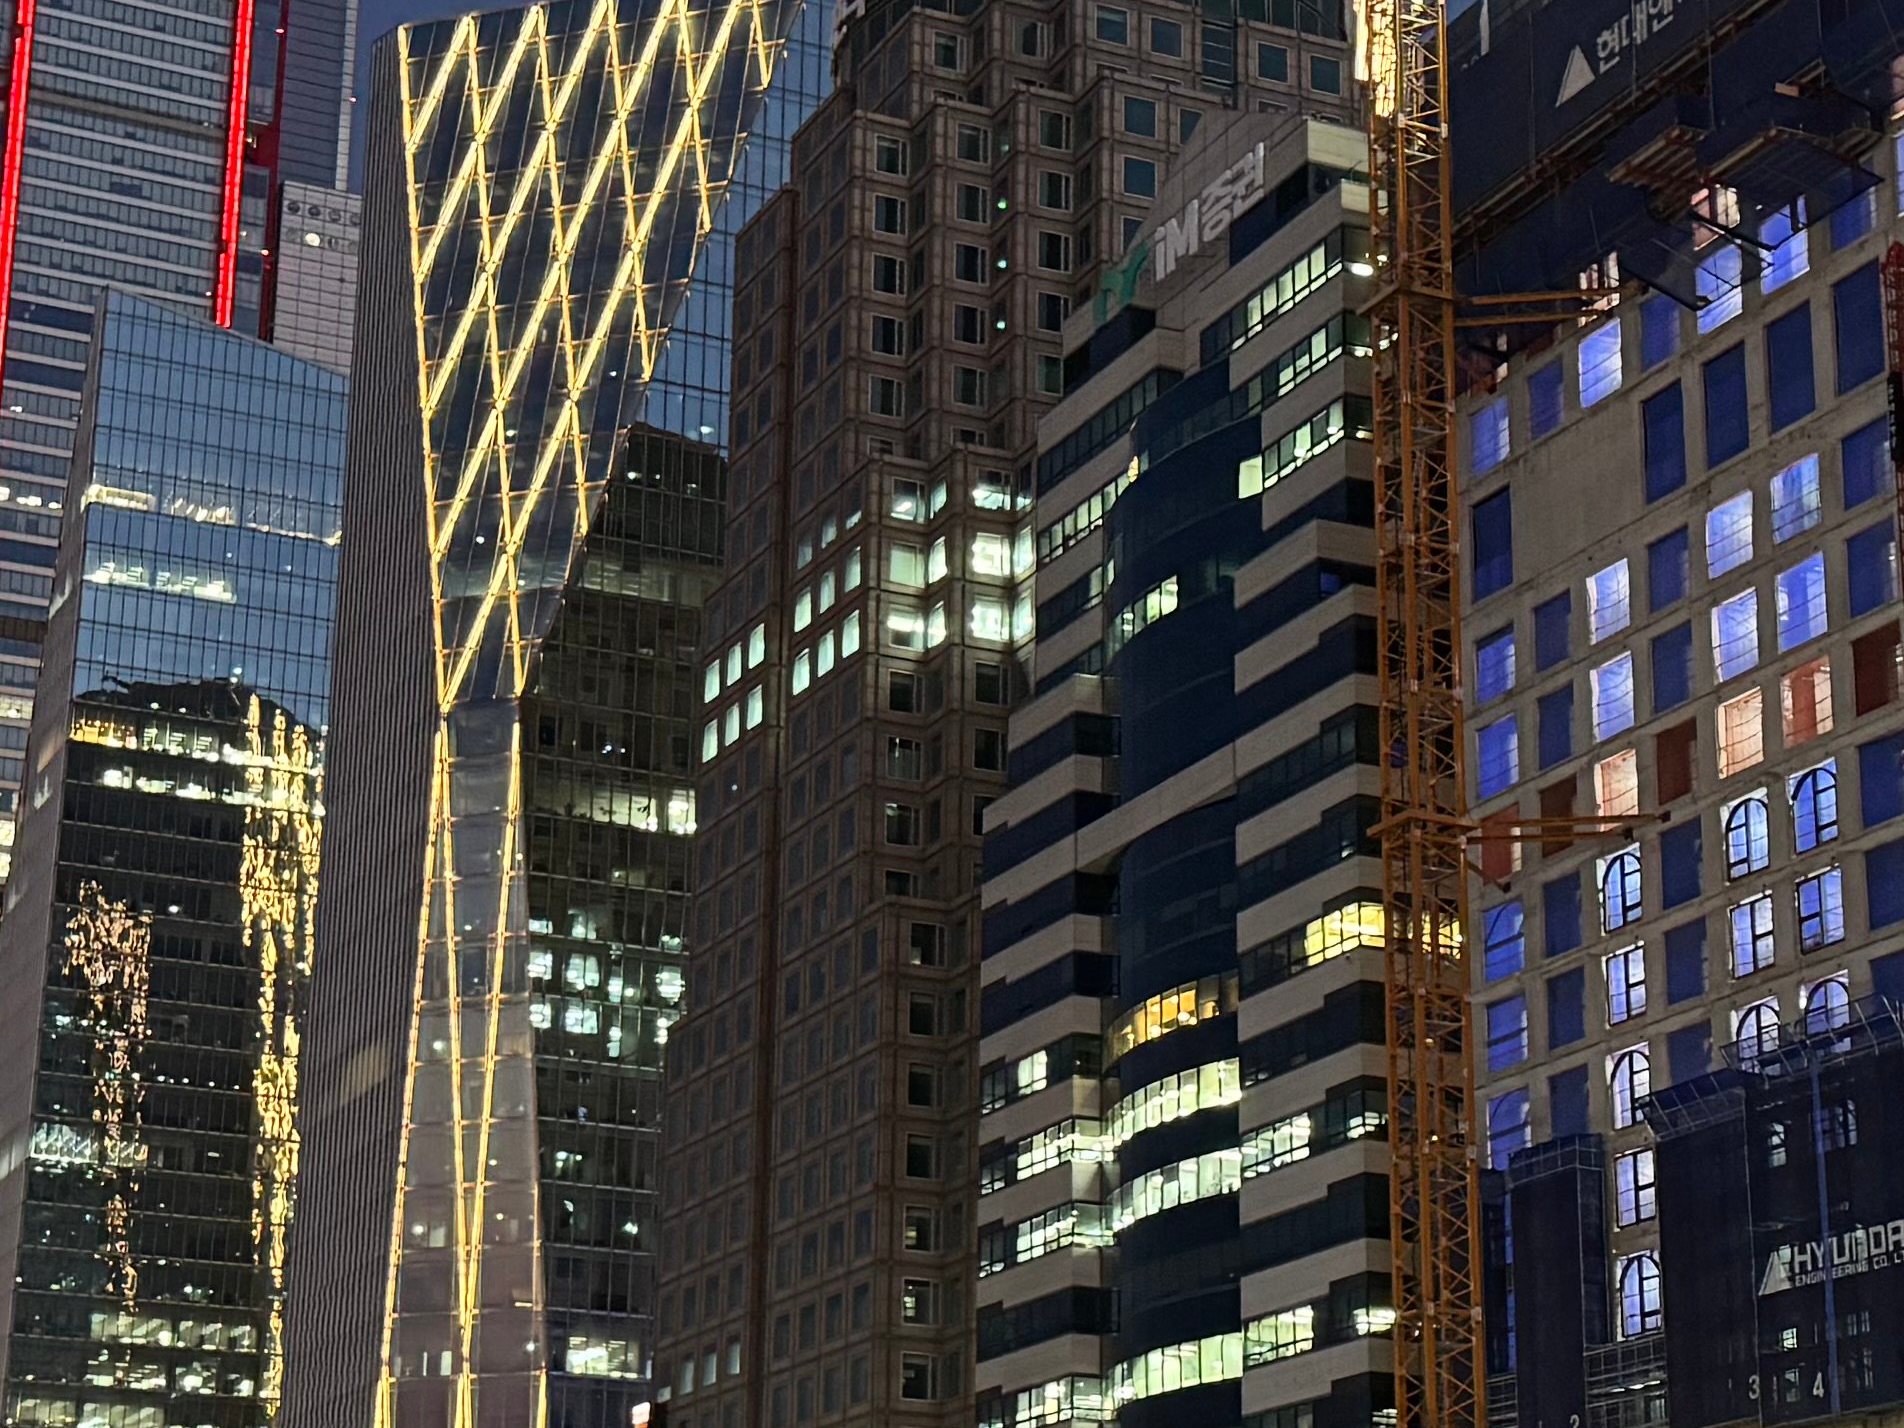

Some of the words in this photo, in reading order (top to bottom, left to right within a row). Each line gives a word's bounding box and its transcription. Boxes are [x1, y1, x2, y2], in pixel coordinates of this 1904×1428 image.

[1154, 142, 1265, 282] iM증권
[1748, 1375, 1760, 1400] 3
[1812, 1372, 1825, 1399] 4
